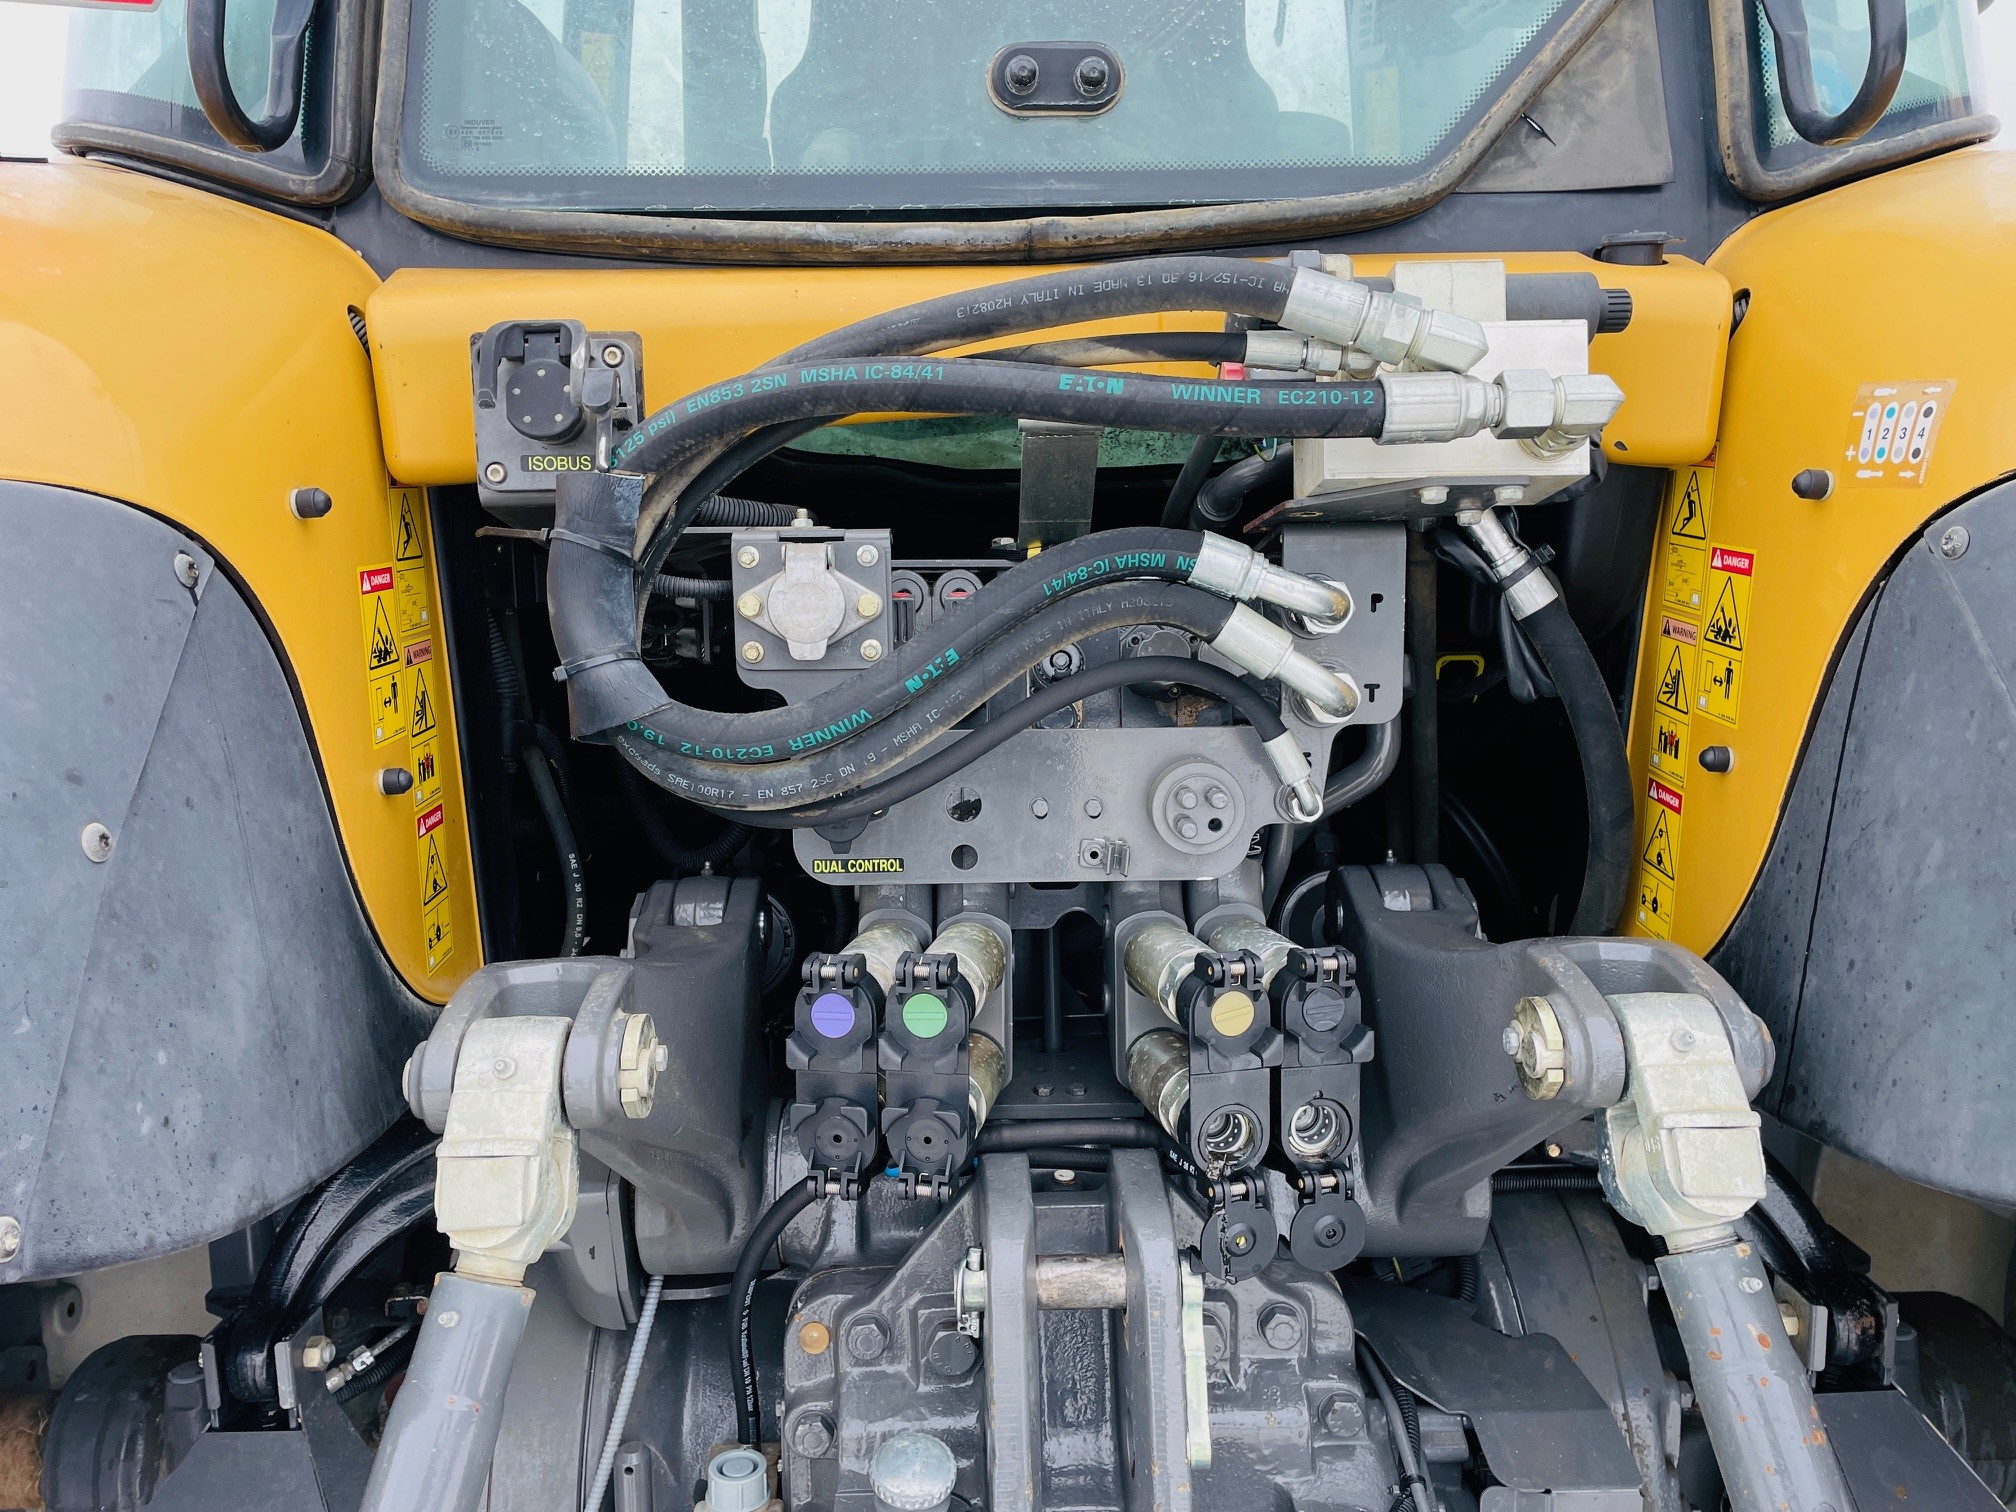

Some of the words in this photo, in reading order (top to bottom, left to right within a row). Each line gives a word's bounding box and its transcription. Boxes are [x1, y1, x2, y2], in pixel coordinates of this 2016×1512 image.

[1093, 278, 1128, 293] MADE
[1136, 275, 1153, 287] 13
[1188, 271, 1265, 289] IC-152/16
[1020, 288, 1060, 306] ITALY
[1068, 284, 1084, 296] IN
[956, 298, 1012, 319] H208213
[647, 410, 677, 436] psi)
[686, 383, 744, 414] EN853
[750, 372, 788, 394] 2SN
[801, 366, 858, 385] MSHA
[865, 364, 944, 382] IC-84/41
[1171, 384, 1262, 405] WINNER
[1278, 389, 1375, 405] EC210-12
[1881, 427, 1890, 440] 2
[1899, 427, 1908, 440] 3
[1918, 426, 1926, 439] 4
[528, 455, 592, 471] ISOBUS
[1115, 552, 1166, 570] MSHA
[1723, 555, 1749, 570] DANGER
[370, 572, 391, 587] DANGER
[1041, 558, 1110, 597] IC-84/41
[1370, 593, 1384, 613] P
[1672, 625, 1697, 641] WARNING
[412, 645, 432, 659] WARNING
[1363, 683, 1381, 703] T
[626, 719, 665, 746] 19.0
[788, 708, 873, 751] WINNER
[680, 741, 774, 760] EC210-12
[757, 788, 774, 799] EN
[780, 783, 804, 797] 857
[838, 762, 856, 779] DN
[892, 722, 923, 748] MSHA
[1658, 788, 1680, 809] DANGER
[425, 810, 443, 829] DANGER
[568, 853, 578, 870] SAE
[813, 860, 846, 873] DUAL
[847, 858, 904, 873] CONTROL
[574, 882, 582, 892] 30
[576, 897, 583, 908] R2
[576, 913, 583, 925] DN
